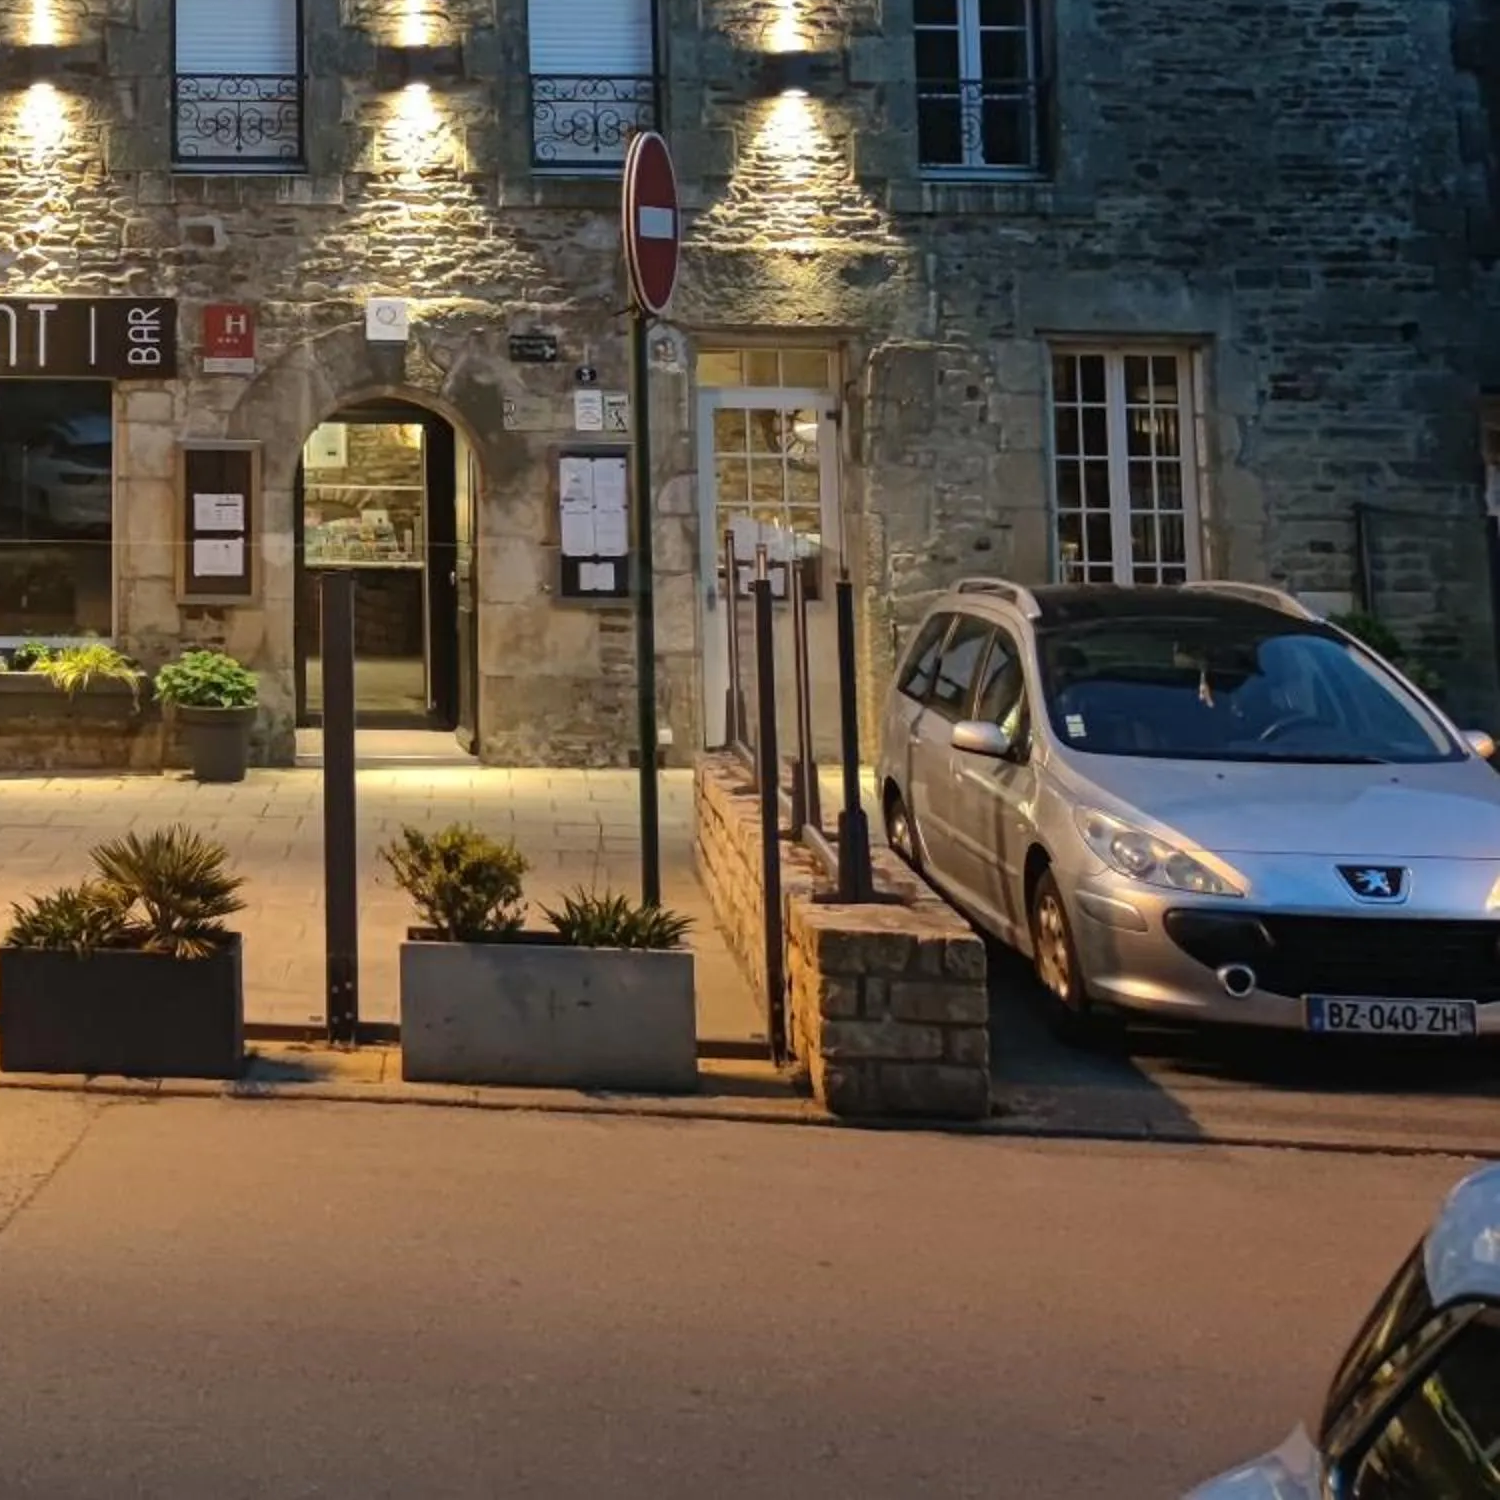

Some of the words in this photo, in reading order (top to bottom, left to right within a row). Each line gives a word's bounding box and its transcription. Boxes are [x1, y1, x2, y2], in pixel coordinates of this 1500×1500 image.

[127, 306, 162, 366] BAR
[225, 314, 246, 335] H
[1327, 1002, 1458, 1033] BZ-040-ZH
